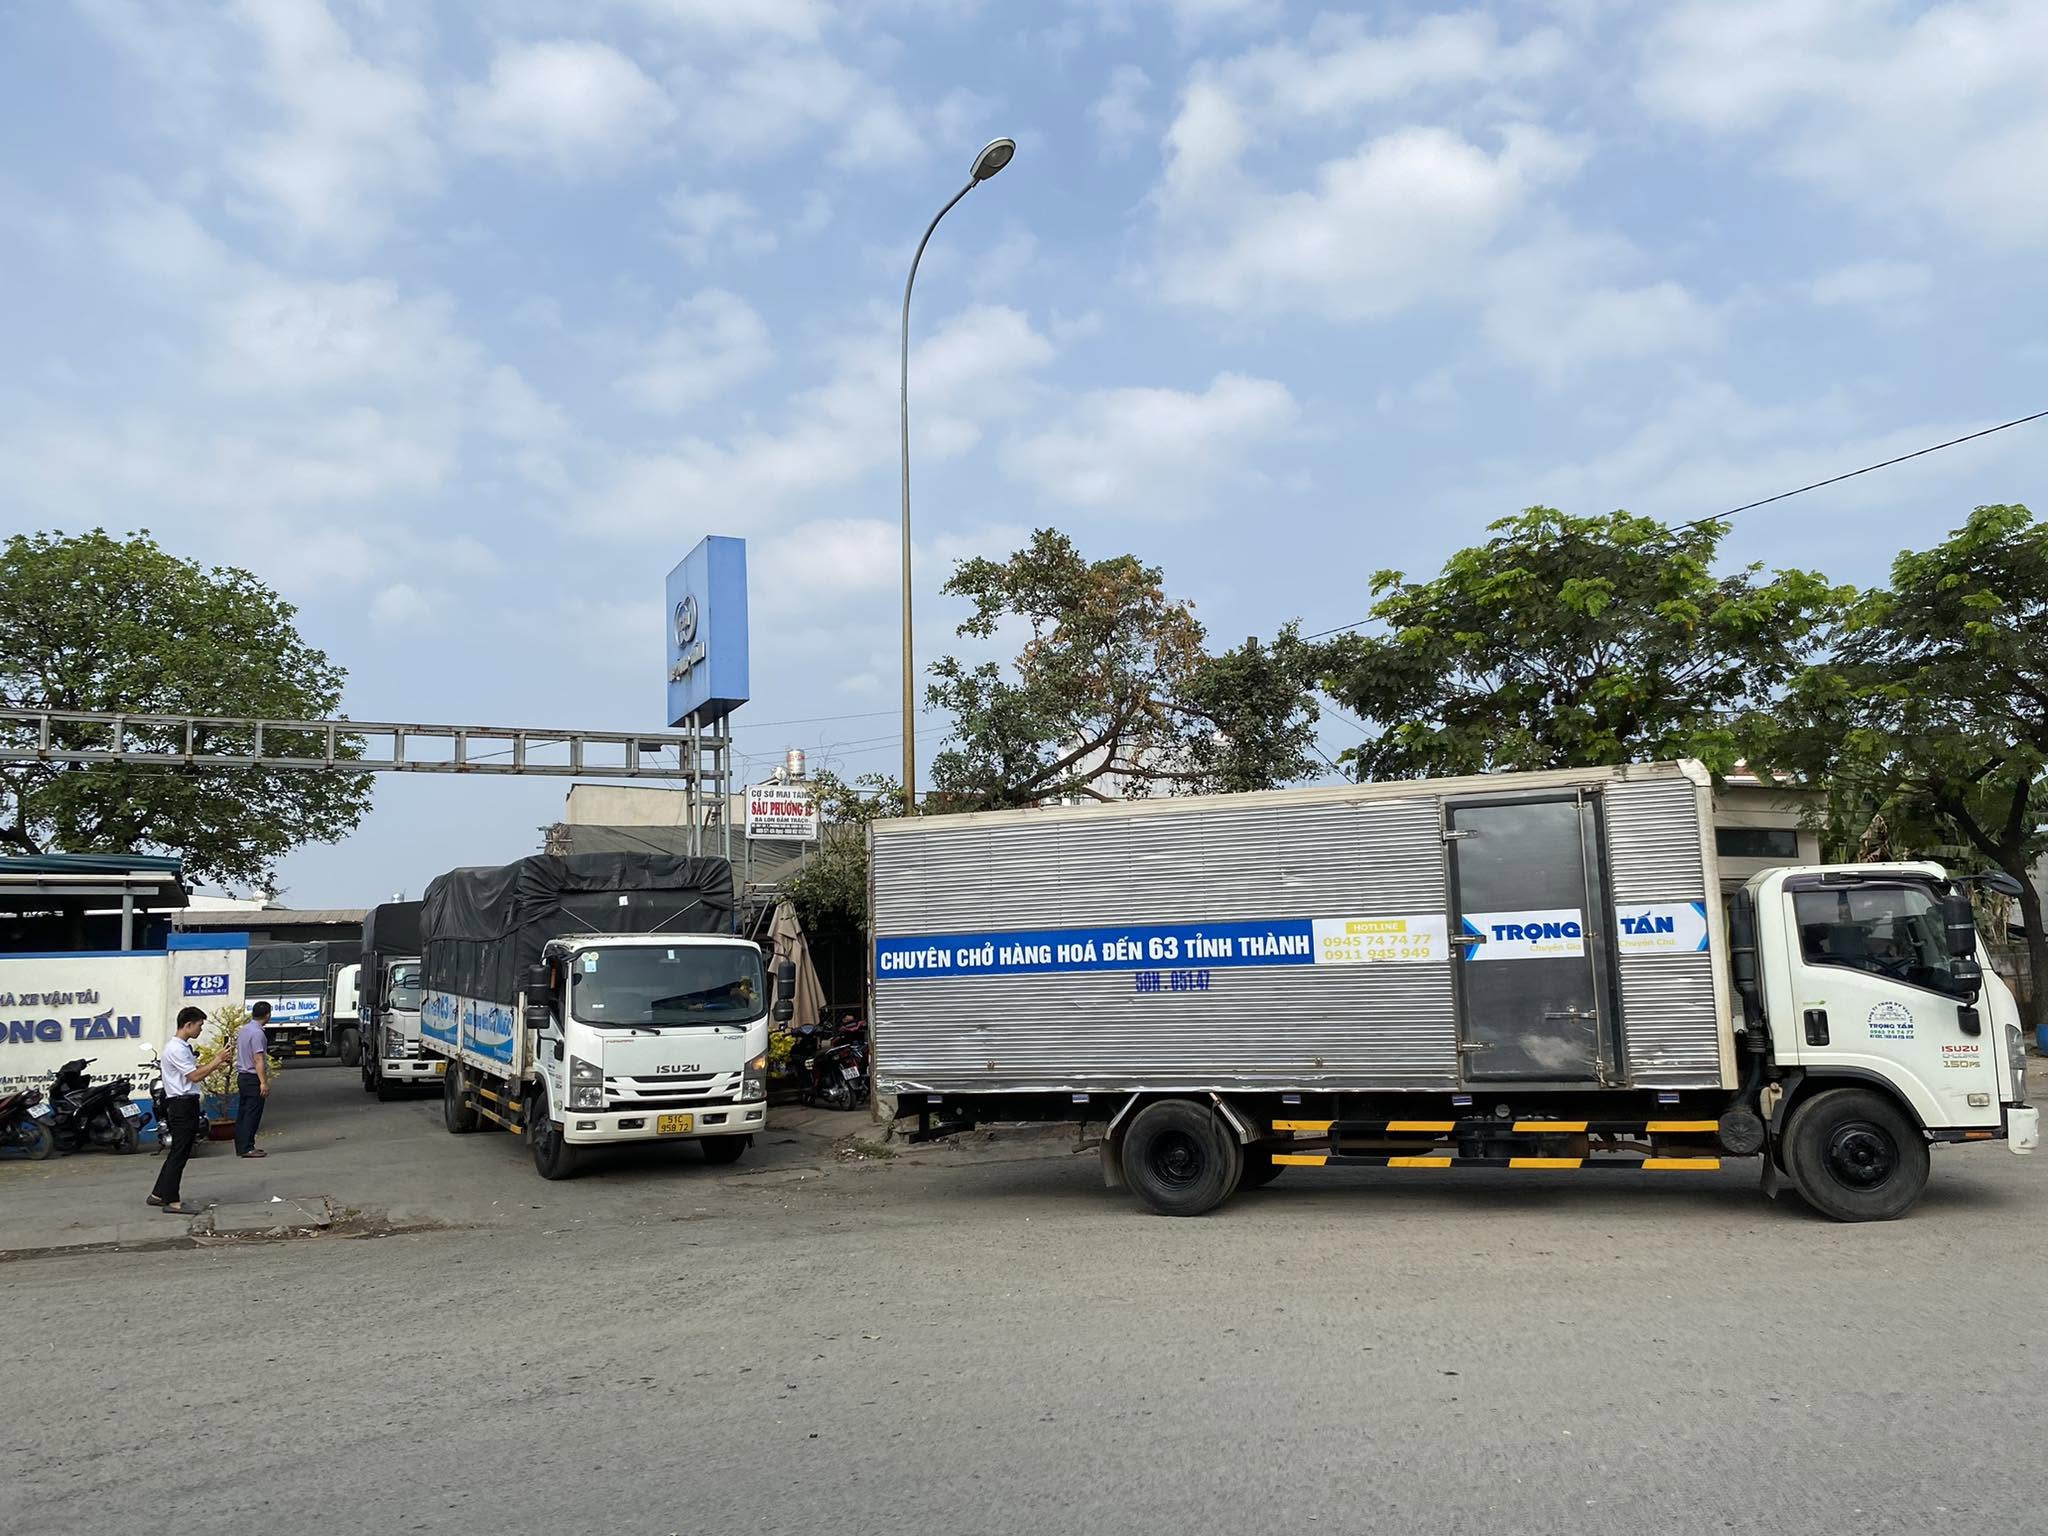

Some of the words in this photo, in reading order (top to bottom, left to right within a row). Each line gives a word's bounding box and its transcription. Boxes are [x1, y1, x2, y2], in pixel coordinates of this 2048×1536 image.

[1353, 923, 1399, 932] HOTLINE
[1491, 922, 1580, 944] TRỌNG
[1323, 936, 1361, 947] 0945
[1367, 936, 1384, 945] 74
[1390, 935, 1408, 945] 74
[1413, 934, 1432, 944] 77
[880, 946, 950, 970] CHUYÊN
[956, 941, 994, 968] CHỞ
[999, 943, 1052, 966] HÀNG
[1057, 938, 1097, 963] HOÁ
[1102, 936, 1142, 962] ĐẾN
[1148, 936, 1179, 958] 63
[1184, 932, 1232, 958] TỈNH
[1238, 931, 1310, 957] THÀNH
[1325, 950, 1362, 960] 0911
[1368, 948, 1396, 959] 945
[1401, 947, 1430, 958] 949
[190, 976, 224, 989] 789
[19, 994, 39, 1006] XE
[42, 991, 73, 1008] VẬN
[656, 1064, 700, 1074] ISUZU
